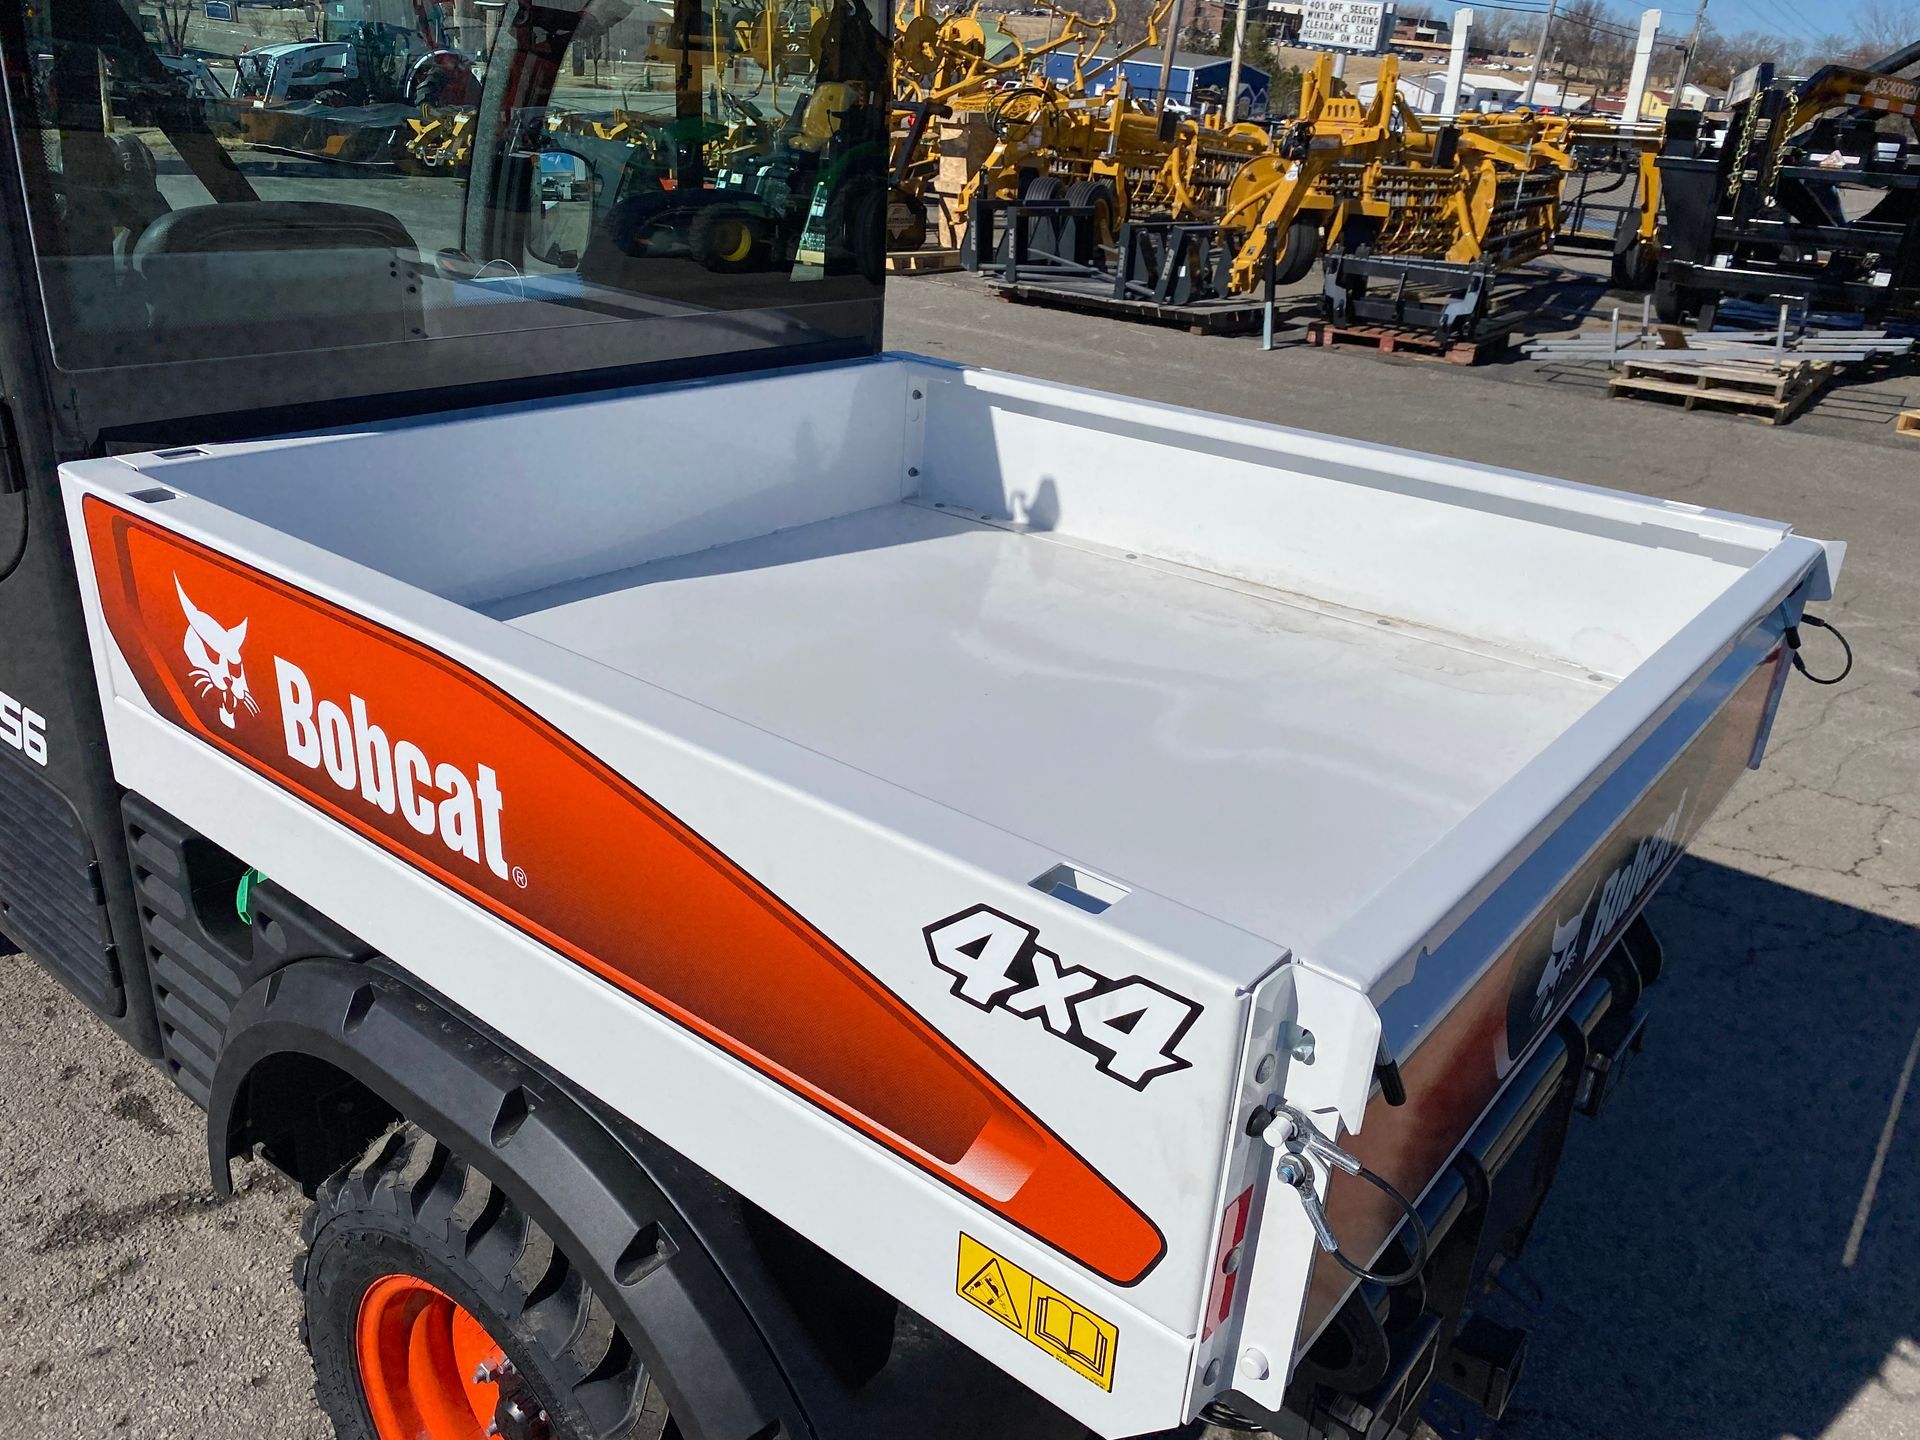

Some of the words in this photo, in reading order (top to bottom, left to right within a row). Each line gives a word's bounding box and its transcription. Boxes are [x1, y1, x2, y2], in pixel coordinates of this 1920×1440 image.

[1329, 3, 1343, 11] OFF
[1350, 5, 1378, 15] SELECT
[1307, 11, 1335, 20] WINTER
[1341, 14, 1379, 26] CLOTHING
[1305, 20, 1348, 32] CLEARANCE
[1355, 26, 1374, 35] SALE
[1303, 30, 1335, 40] HEATING
[1340, 34, 1350, 42] ON
[1354, 36, 1373, 45] SALE
[273, 655, 509, 881] Bobcat
